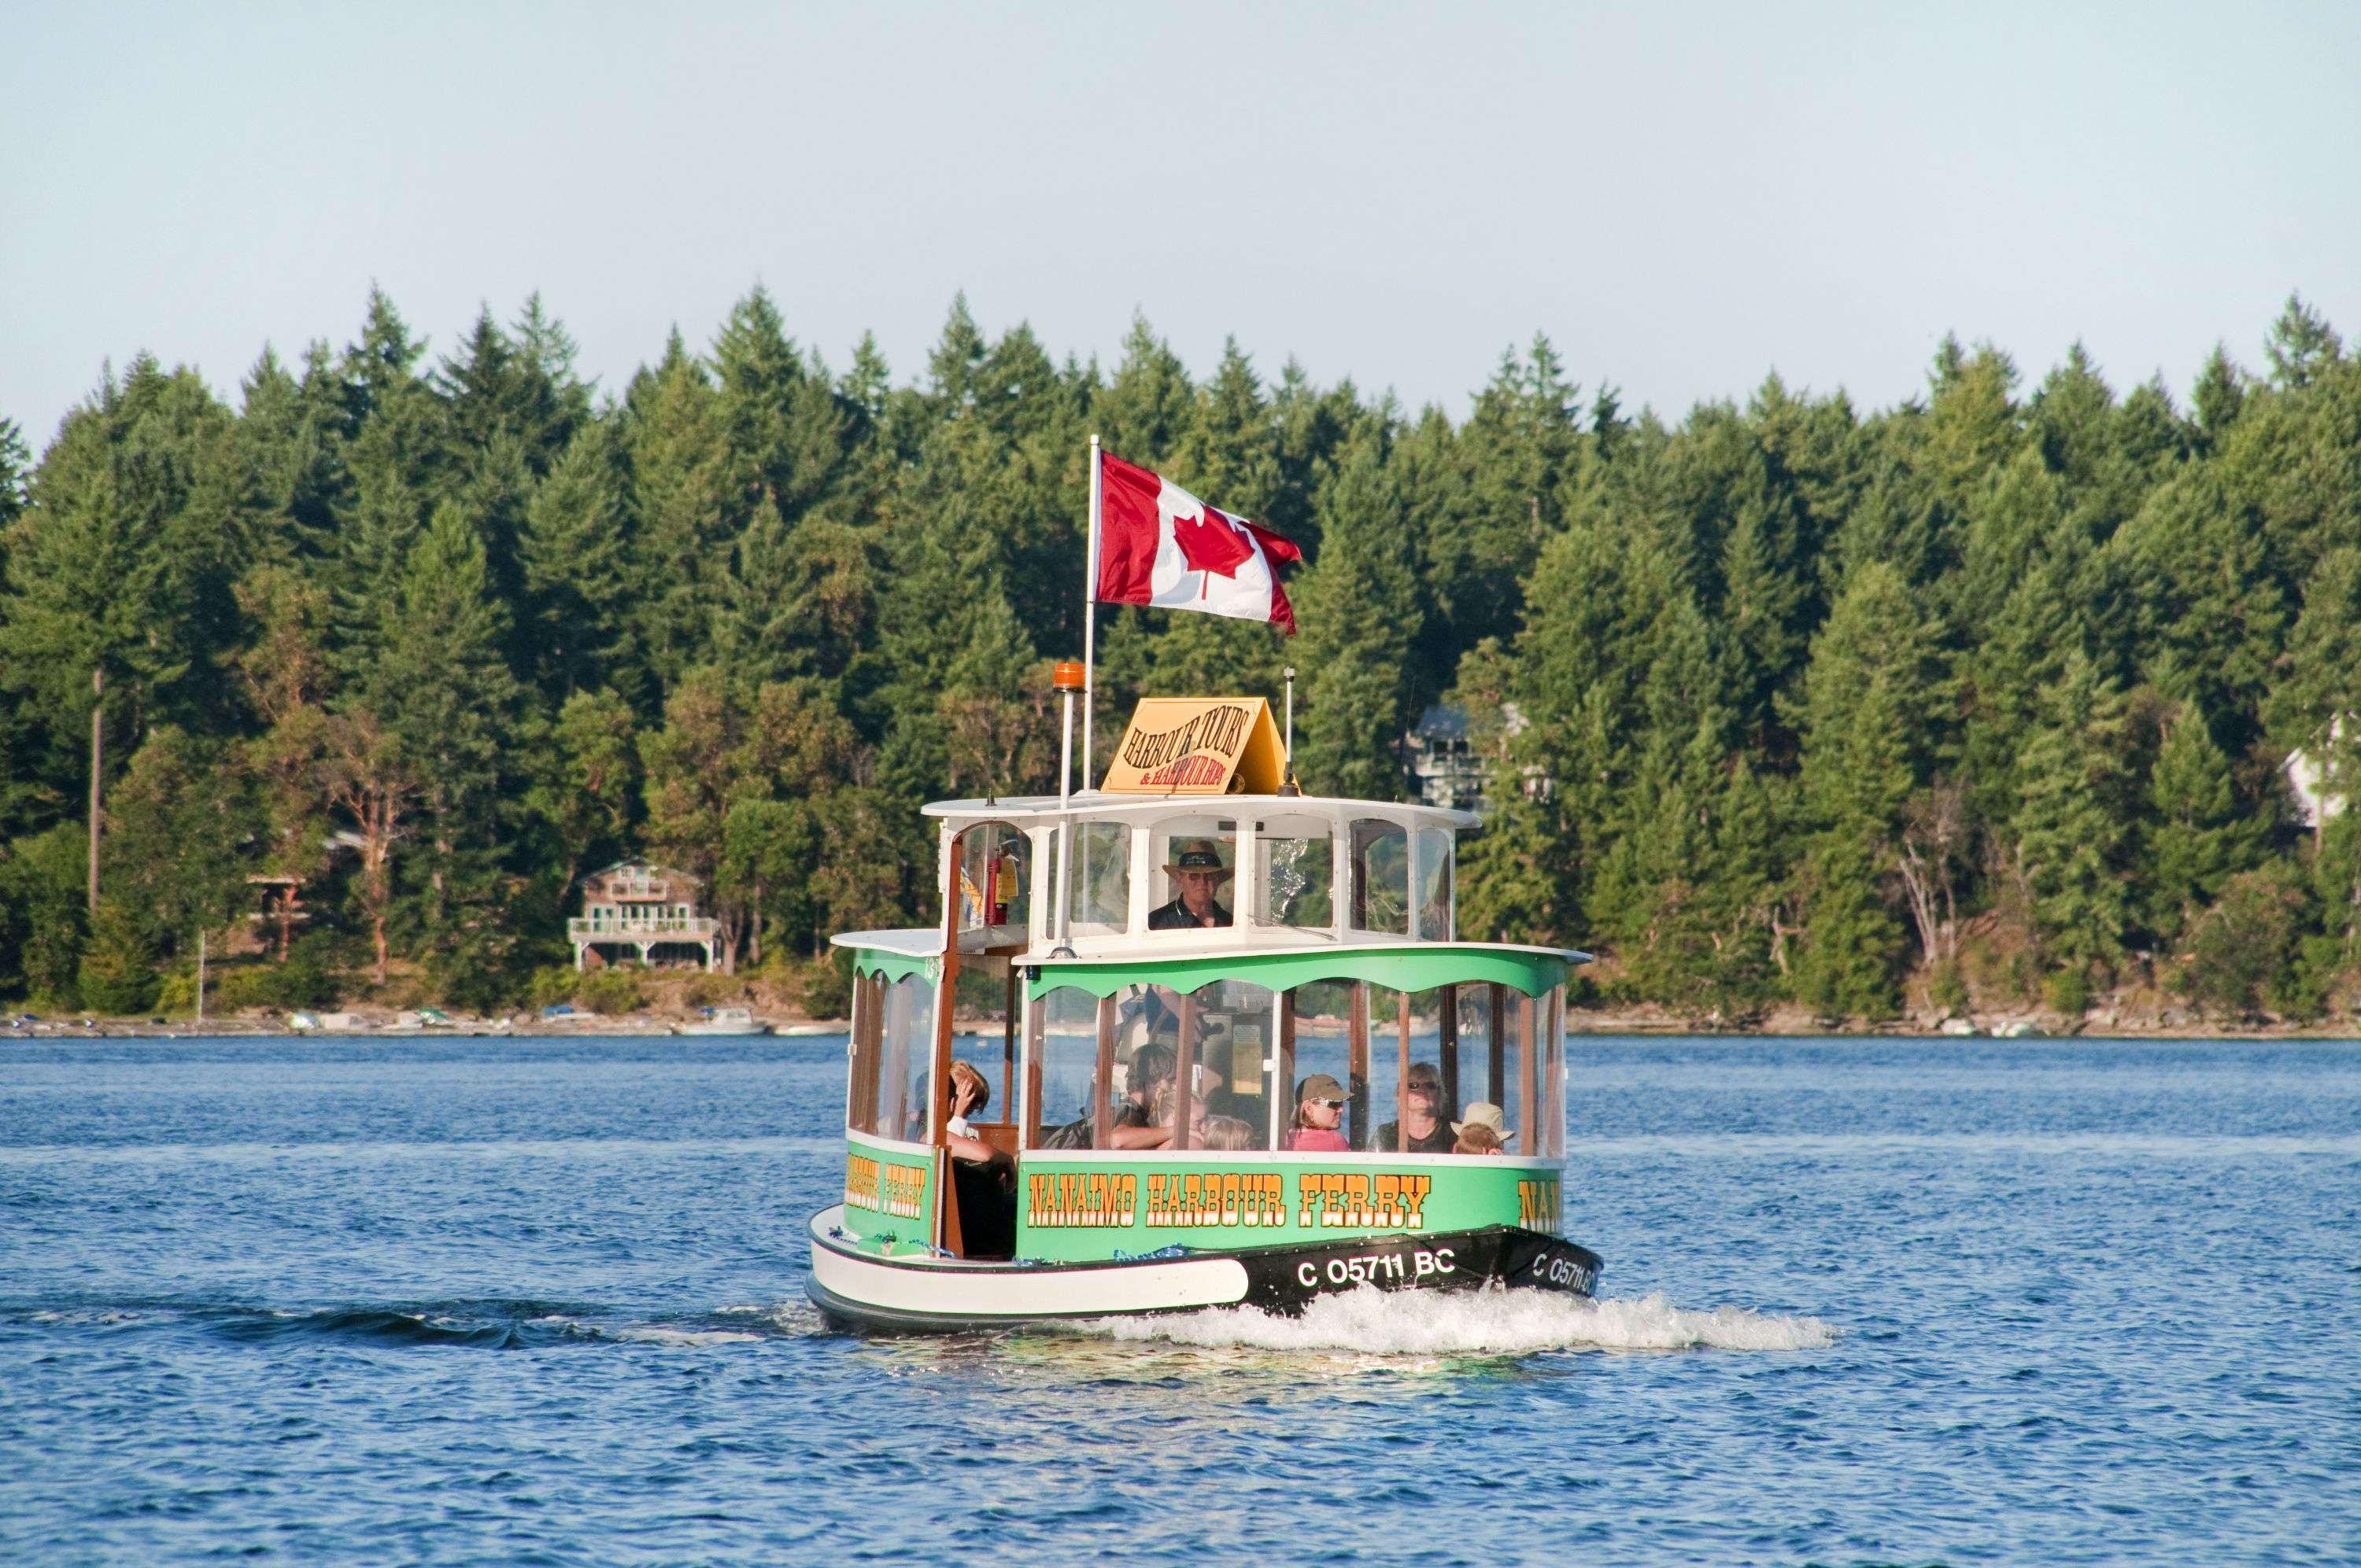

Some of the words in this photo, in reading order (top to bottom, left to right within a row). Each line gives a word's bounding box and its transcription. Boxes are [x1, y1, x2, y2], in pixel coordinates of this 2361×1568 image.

[1123, 715, 1201, 769] HARBOUR
[1193, 705, 1250, 758] TOURS
[1140, 772, 1151, 785] &
[1151, 754, 1210, 786] HARBOUR
[883, 1163, 926, 1221] FERRY
[1028, 1173, 1136, 1228] NANAIMO
[1146, 1173, 1286, 1228] HARBOUR
[1299, 1174, 1431, 1229] FERRY
[1299, 1262, 1317, 1287] C
[1414, 1248, 1455, 1275] BC
[1533, 1253, 1547, 1276] C
